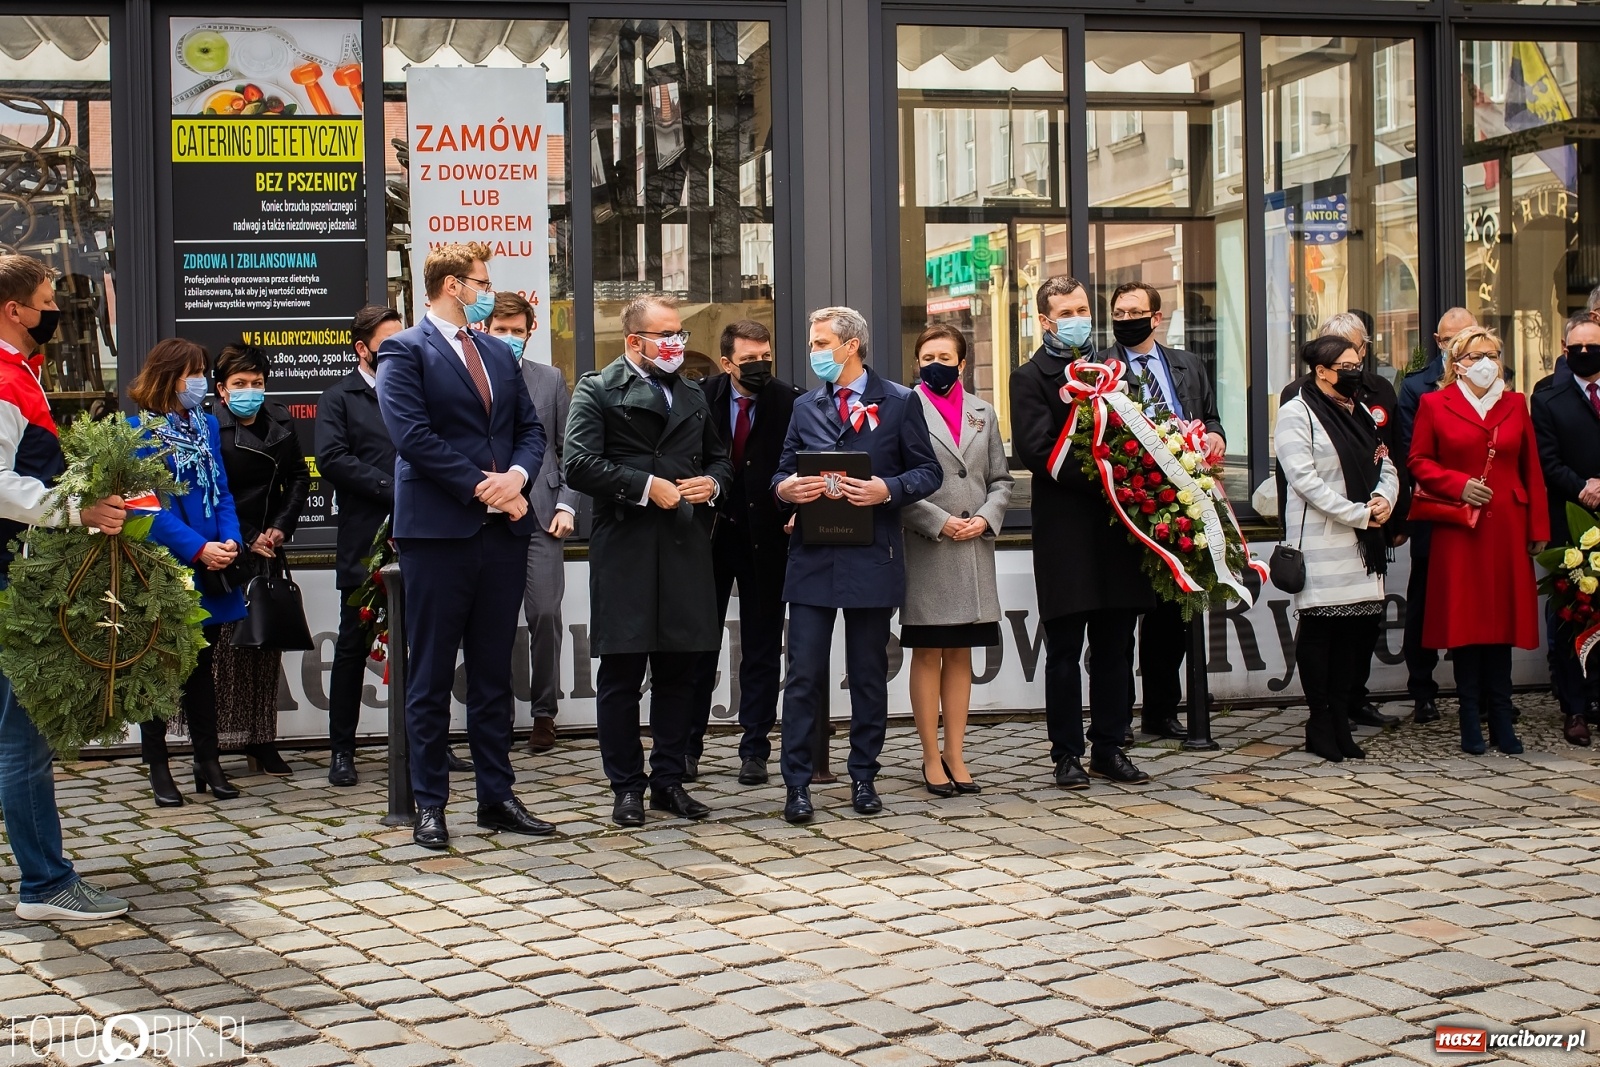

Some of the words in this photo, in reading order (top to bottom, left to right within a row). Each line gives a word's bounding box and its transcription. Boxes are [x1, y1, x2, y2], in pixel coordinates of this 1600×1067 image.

[177, 125, 251, 157] CATERING
[256, 125, 359, 157] DIETETYCZNY
[415, 116, 542, 152] ZAMÓW
[420, 164, 431, 181] Z
[438, 164, 538, 181] DOWOZEM
[255, 172, 283, 192] BEZ
[288, 172, 358, 192] PSZENICY
[461, 189, 500, 206] LUB
[261, 200, 284, 212] Koniec
[284, 200, 310, 212] brzucha
[310, 200, 354, 215] pszenicznego
[428, 215, 533, 232] ODBIOREM
[1305, 211, 1340, 221] ANTOR
[233, 219, 261, 234] nadwagi
[261, 222, 266, 231] a
[266, 219, 285, 231] także
[285, 218, 327, 234] niezdrowego
[327, 218, 357, 234] jedzenia!
[183, 253, 228, 269] ZDROWA
[230, 253, 234, 269] I
[237, 252, 318, 269] ZBILANSOWANA
[184, 275, 230, 286] Profesjonalnie
[231, 276, 270, 285] opracowana
[271, 277, 289, 286] przez
[289, 274, 320, 284] dietetyka
[188, 287, 234, 298] zbilansowana,
[234, 287, 245, 296] tak
[246, 287, 258, 298] aby
[258, 287, 268, 298] jej
[296, 286, 328, 298] odżywcze
[184, 300, 213, 310] spełniały
[214, 299, 245, 310] wszystkie
[246, 300, 273, 310] wymogi
[273, 299, 311, 310] żywieniowe
[242, 331, 251, 346] W
[254, 331, 261, 346] 5
[263, 328, 352, 346] KALORYCZNOŚCIAC
[274, 352, 297, 367] 1800,
[299, 354, 321, 366] 2000,
[322, 354, 343, 367] 2500
[288, 367, 318, 379] lubiących
[319, 367, 341, 377] dobrze
[1115, 402, 1165, 456] SENATOR
[1162, 453, 1185, 478] RP
[306, 495, 325, 508] 130
[298, 514, 325, 522] nna.com
[819, 525, 854, 534] Racibórz
[1206, 562, 1456, 692] Rye
